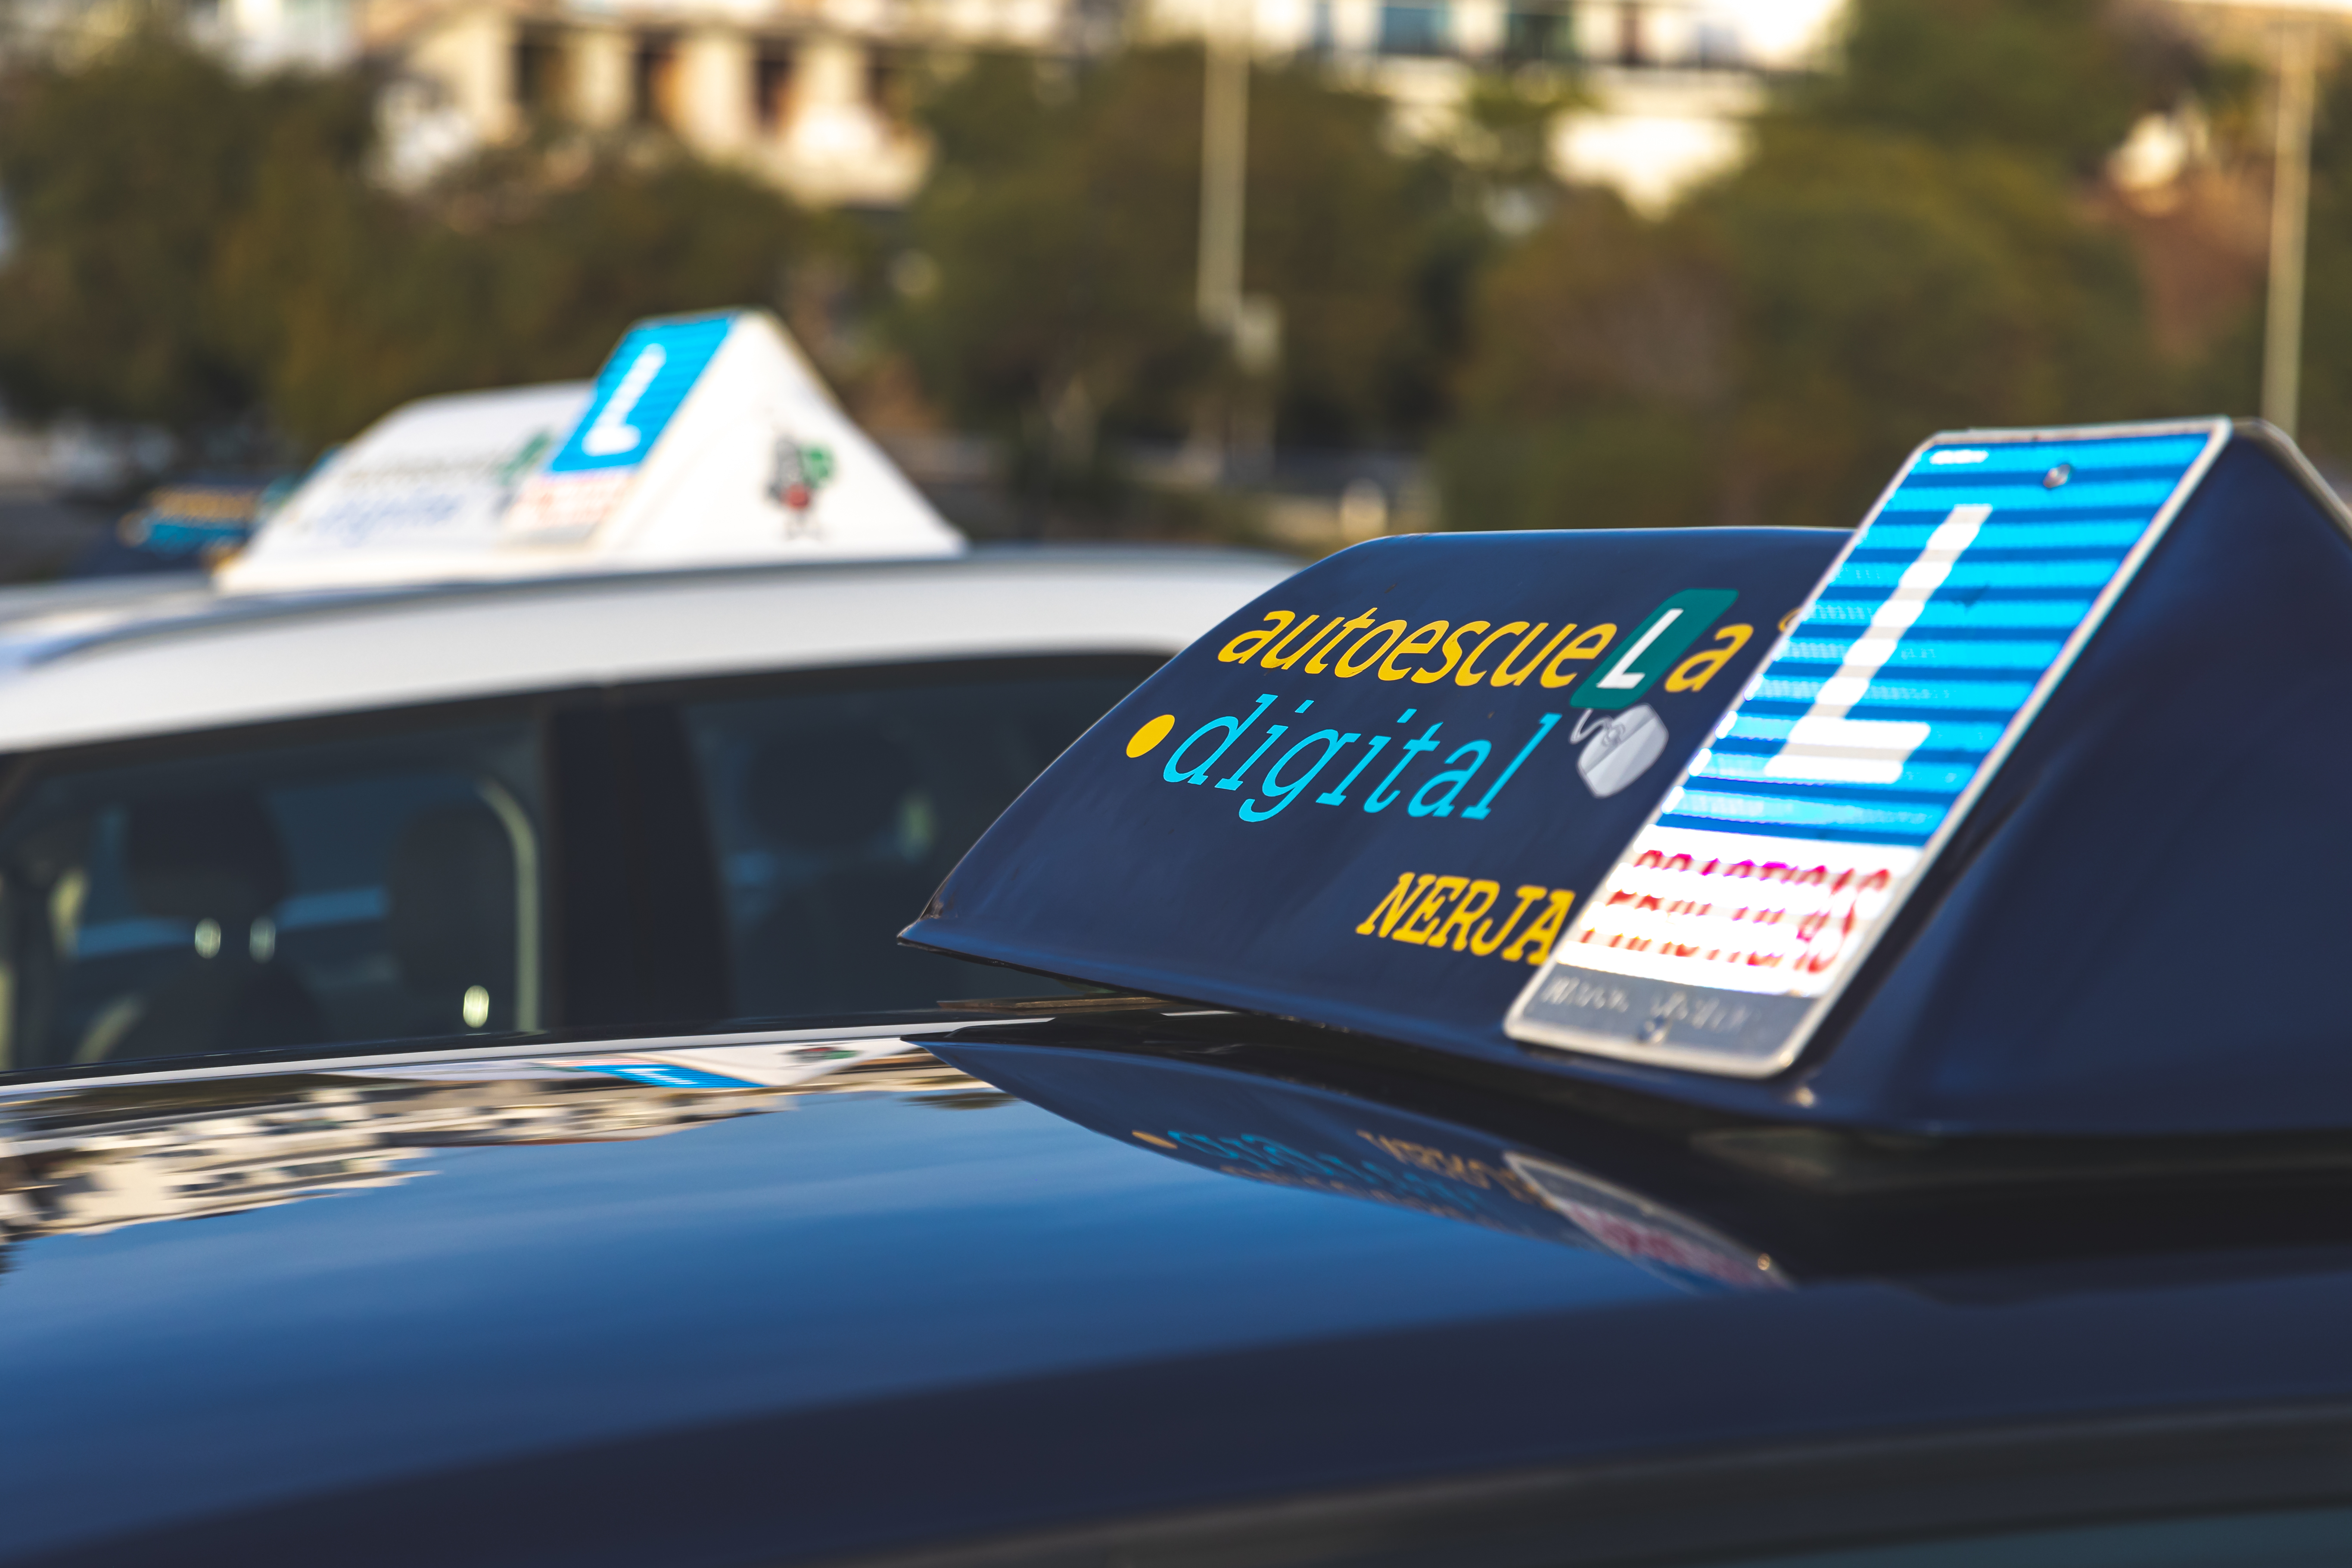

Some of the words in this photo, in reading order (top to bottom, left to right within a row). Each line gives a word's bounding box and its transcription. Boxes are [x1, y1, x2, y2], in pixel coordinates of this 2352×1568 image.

[581, 343, 667, 457] L
[1217, 607, 1754, 692] autoescueLa
[1764, 505, 1993, 784] L
[1162, 693, 1562, 823] digital
[1355, 871, 1576, 967] NERJA
